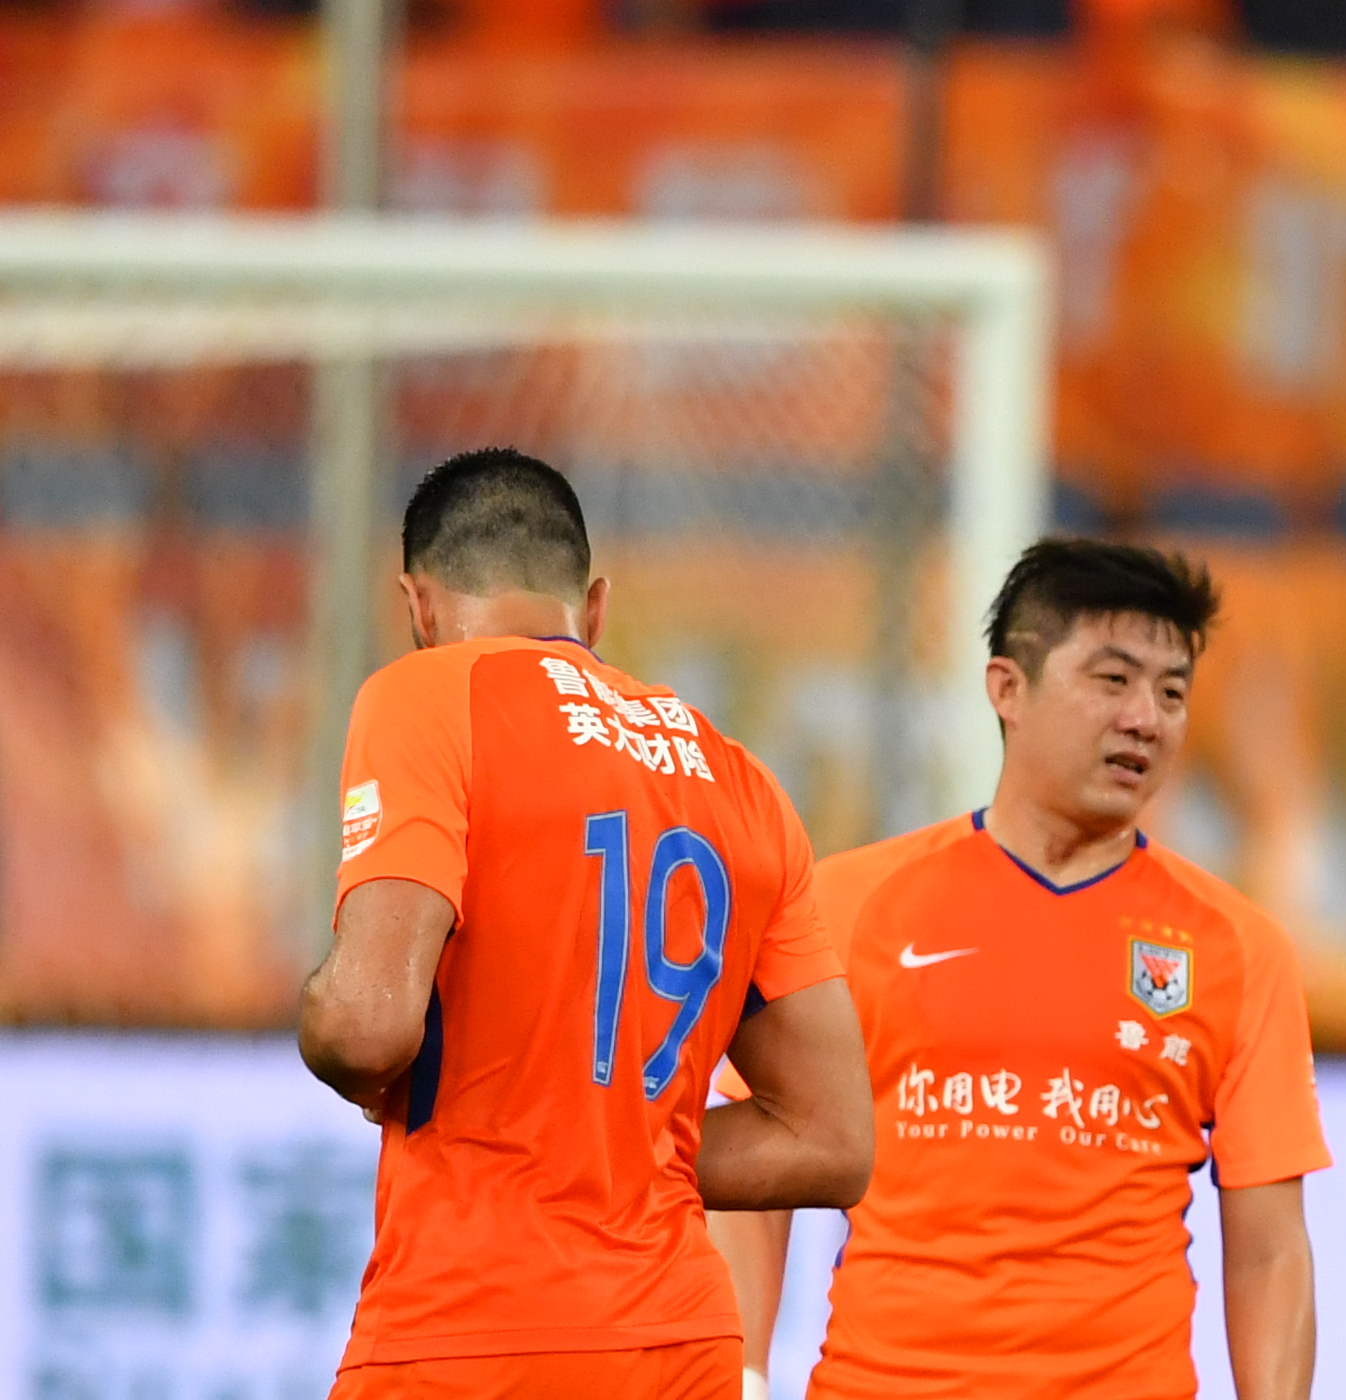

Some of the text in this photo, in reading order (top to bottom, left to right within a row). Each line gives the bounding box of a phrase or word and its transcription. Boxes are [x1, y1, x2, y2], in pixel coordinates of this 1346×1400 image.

[584, 809, 731, 1102] 19
[896, 1119, 949, 1140] Your
[960, 1119, 1039, 1142] Power
[1060, 1125, 1107, 1148] Our
